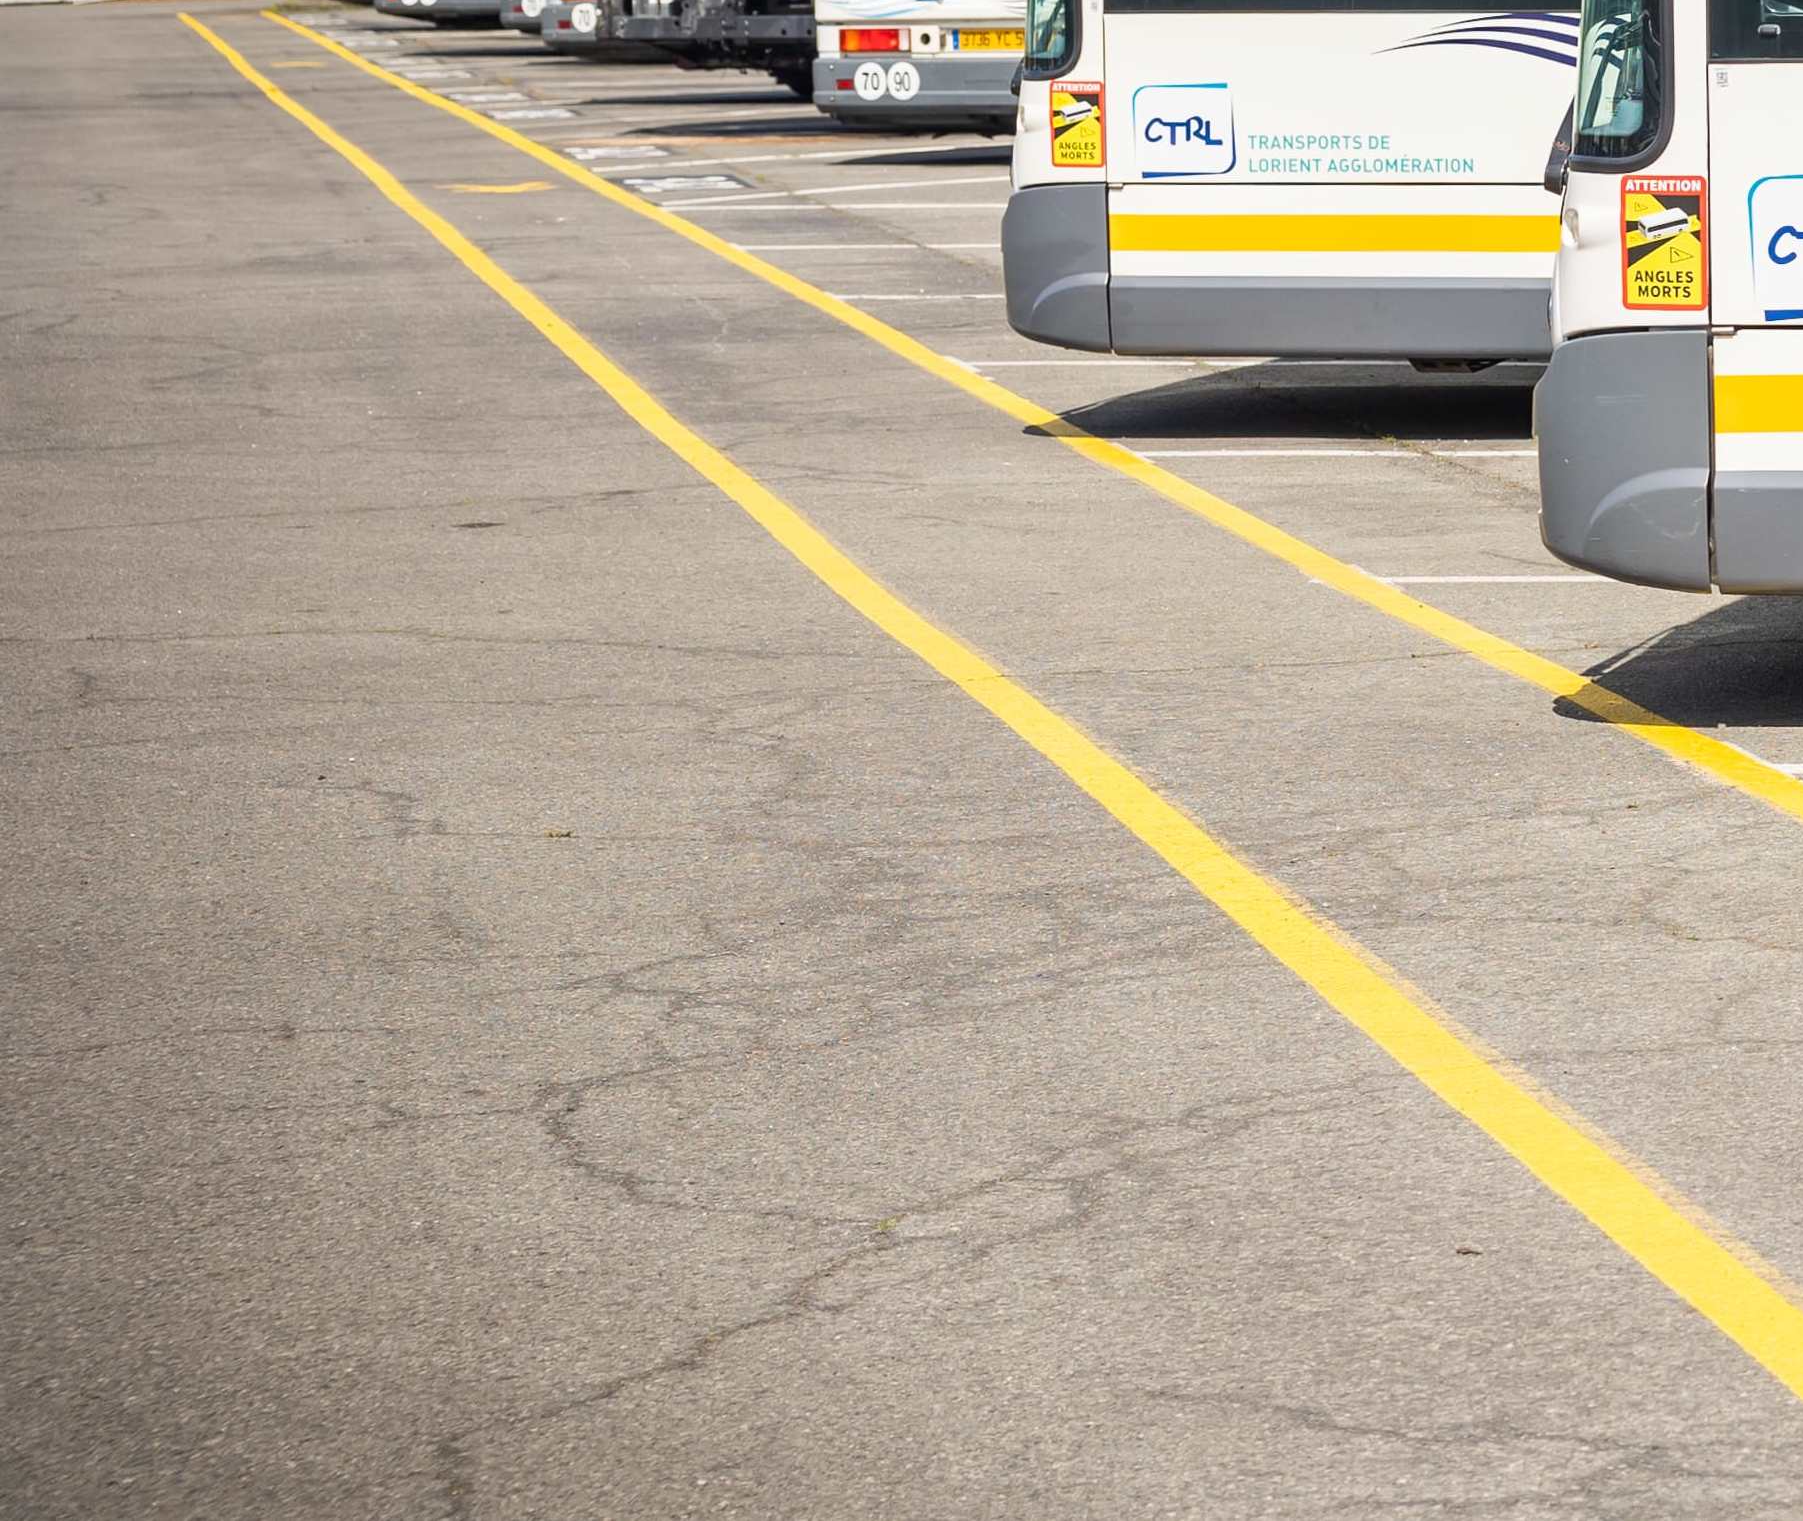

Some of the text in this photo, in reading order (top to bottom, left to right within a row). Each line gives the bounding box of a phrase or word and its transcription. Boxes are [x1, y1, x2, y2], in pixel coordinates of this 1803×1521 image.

[960, 31, 990, 47] 3736
[995, 31, 1010, 47] YC
[861, 72, 880, 91] 70
[894, 72, 911, 92] 90
[1052, 83, 1101, 92] ATTENTION
[1144, 116, 1223, 146] CTRL
[1058, 141, 1097, 151] ANGLES
[1248, 135, 1390, 150] TRANSPORTS DE
[1060, 151, 1096, 161] MORTS
[1249, 154, 1474, 173] LORIENT AGGLOMÉRATION
[1625, 179, 1702, 192] ATTENTION
[1634, 270, 1694, 283] ANGLES
[1638, 284, 1691, 298] MORTS
